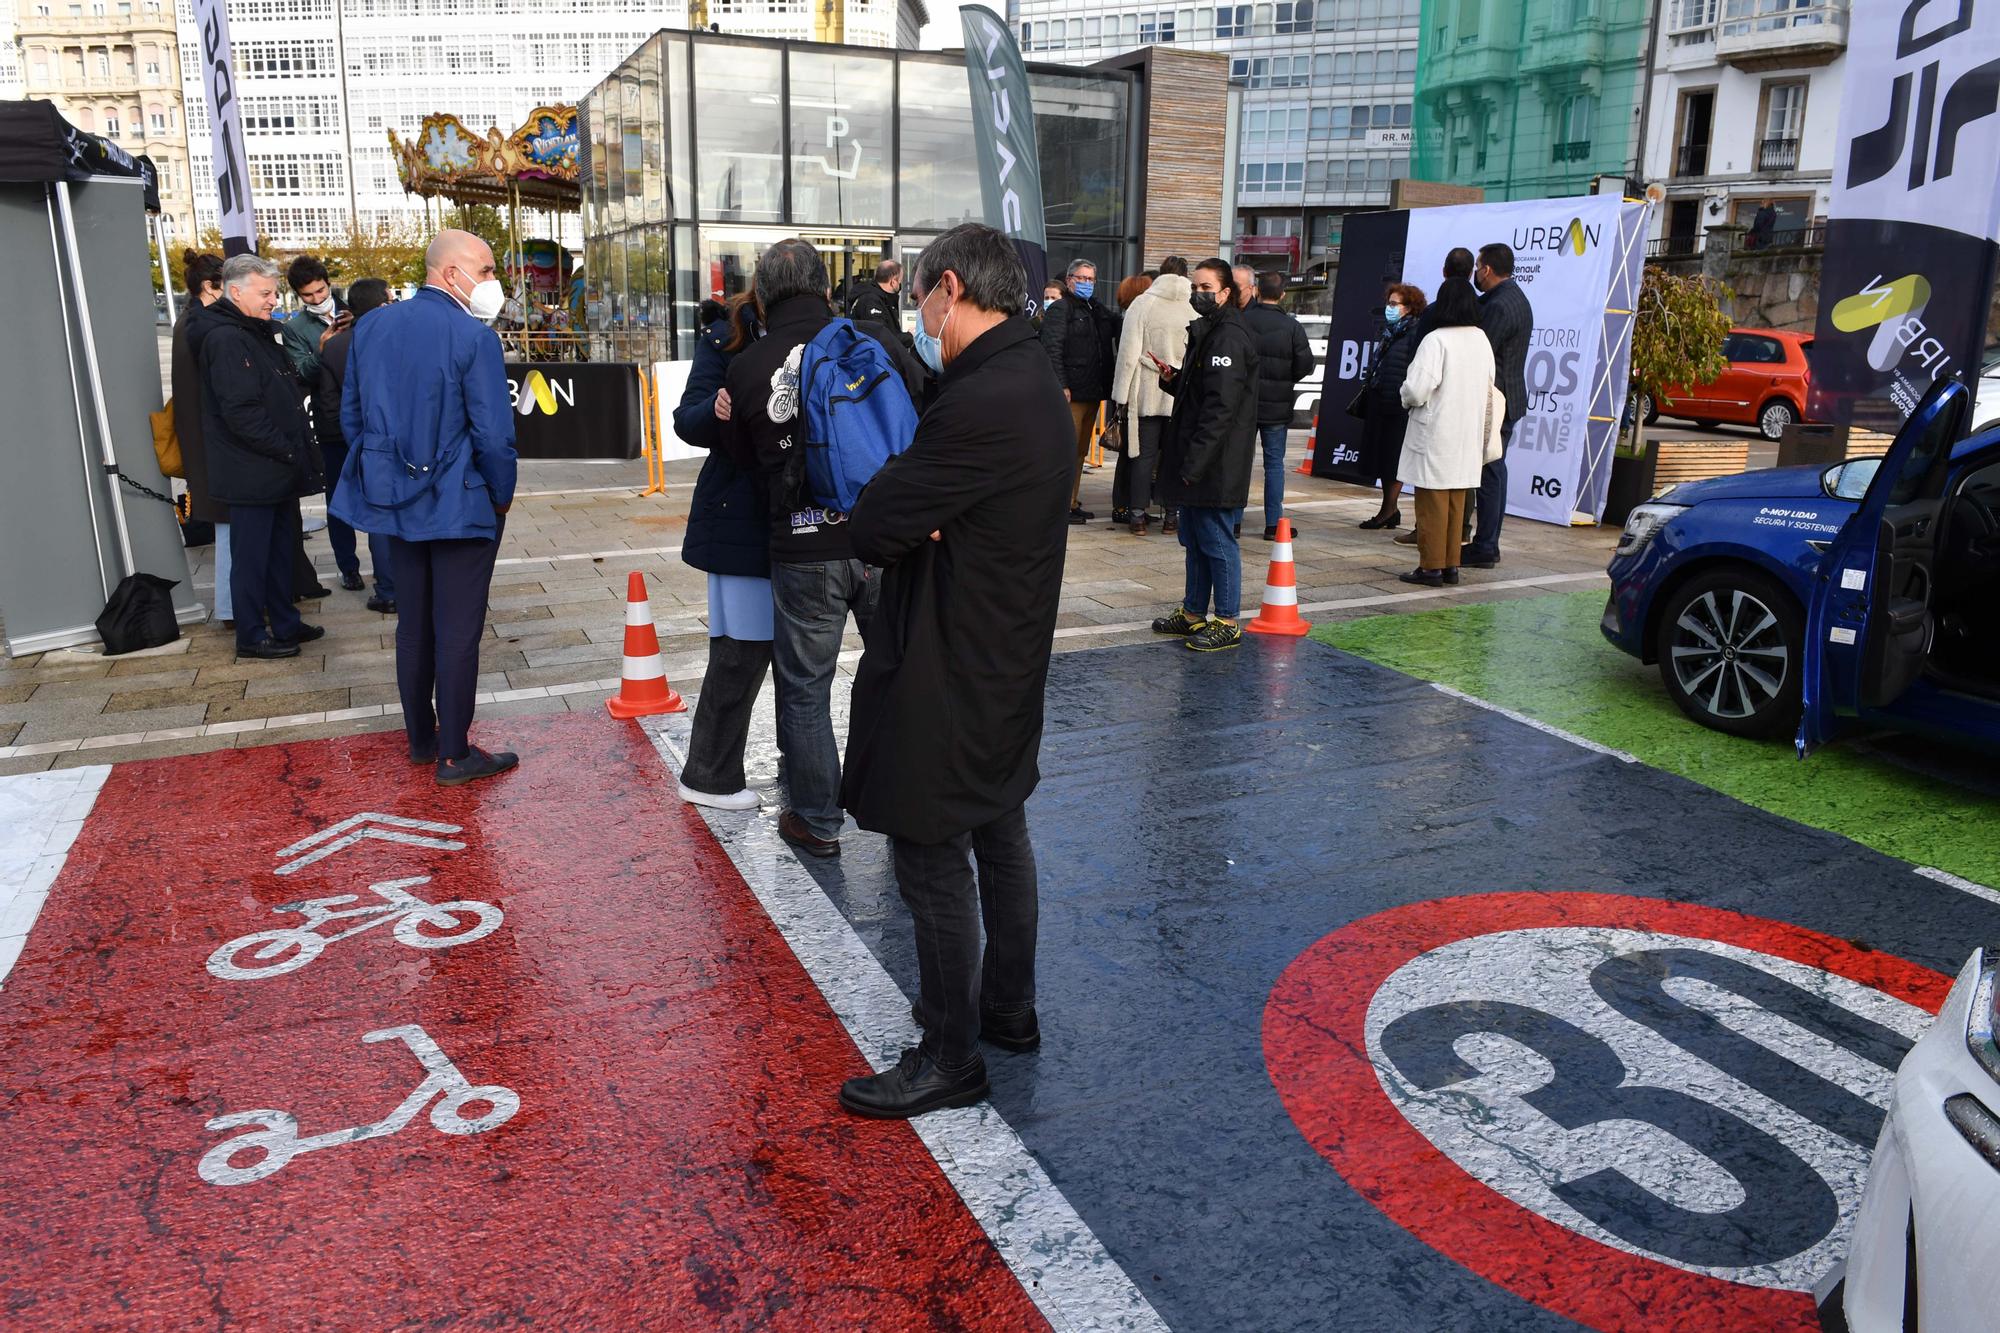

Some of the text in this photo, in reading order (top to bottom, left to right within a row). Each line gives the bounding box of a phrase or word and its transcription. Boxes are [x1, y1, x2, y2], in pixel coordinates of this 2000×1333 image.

[826, 116, 849, 148] P
[1513, 217, 1601, 256] URBAN
[1212, 356, 1232, 367] RG
[1556, 402, 1574, 454] VIDOS
[1531, 475, 1562, 498] RG
[1753, 516, 1842, 534] SEGURA Y SOSTENIBL
[1380, 949, 1917, 1268] 30
